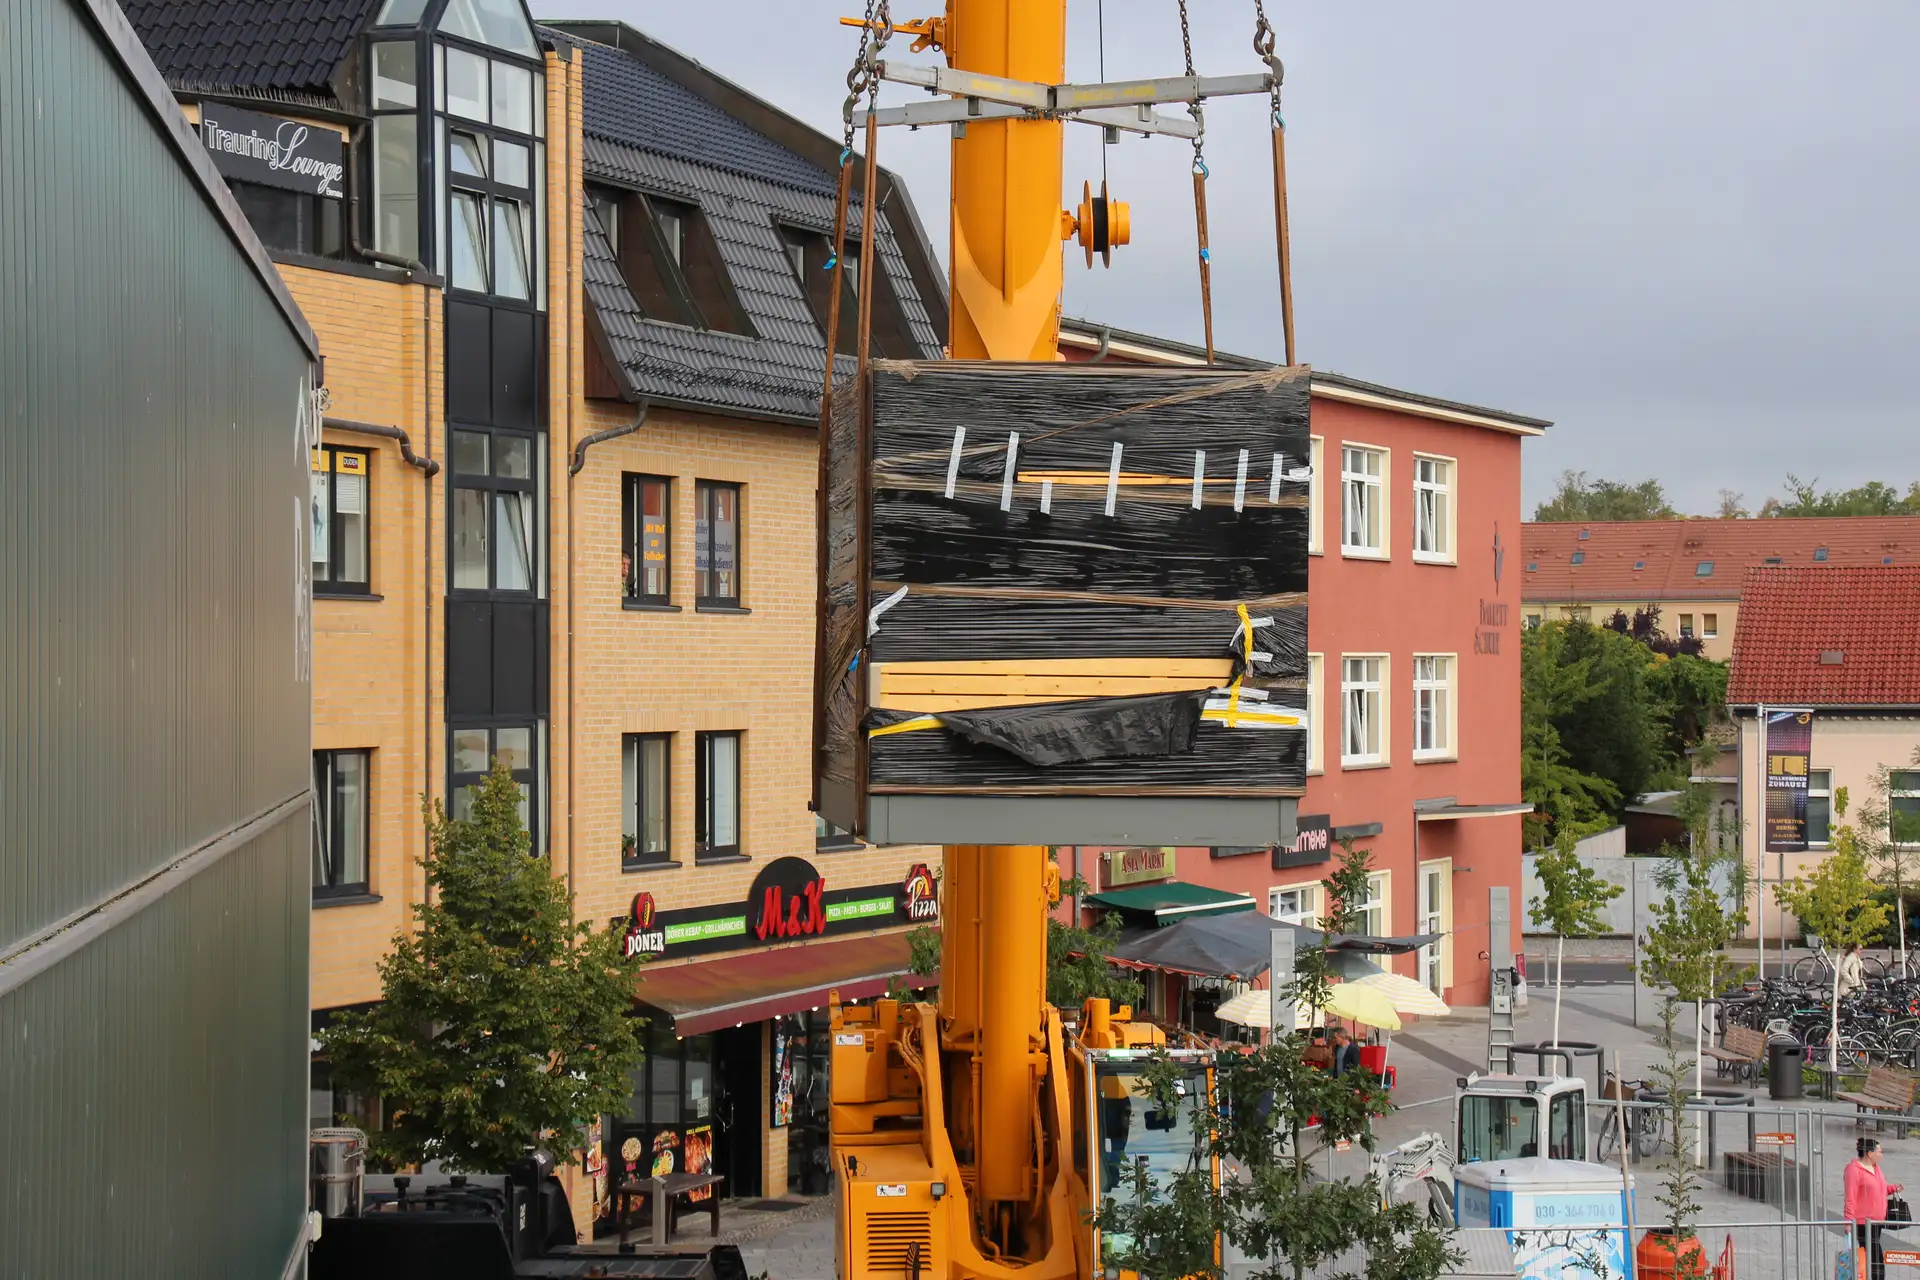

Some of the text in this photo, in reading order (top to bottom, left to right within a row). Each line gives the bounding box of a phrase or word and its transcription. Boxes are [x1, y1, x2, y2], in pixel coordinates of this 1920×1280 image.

[205, 119, 343, 194] Trauring Lounge
[1121, 851, 1166, 873] ASIA MARKT
[906, 876, 938, 920] Pizza
[627, 929, 665, 957] DÖNER
[1535, 1205, 1555, 1219] 030
